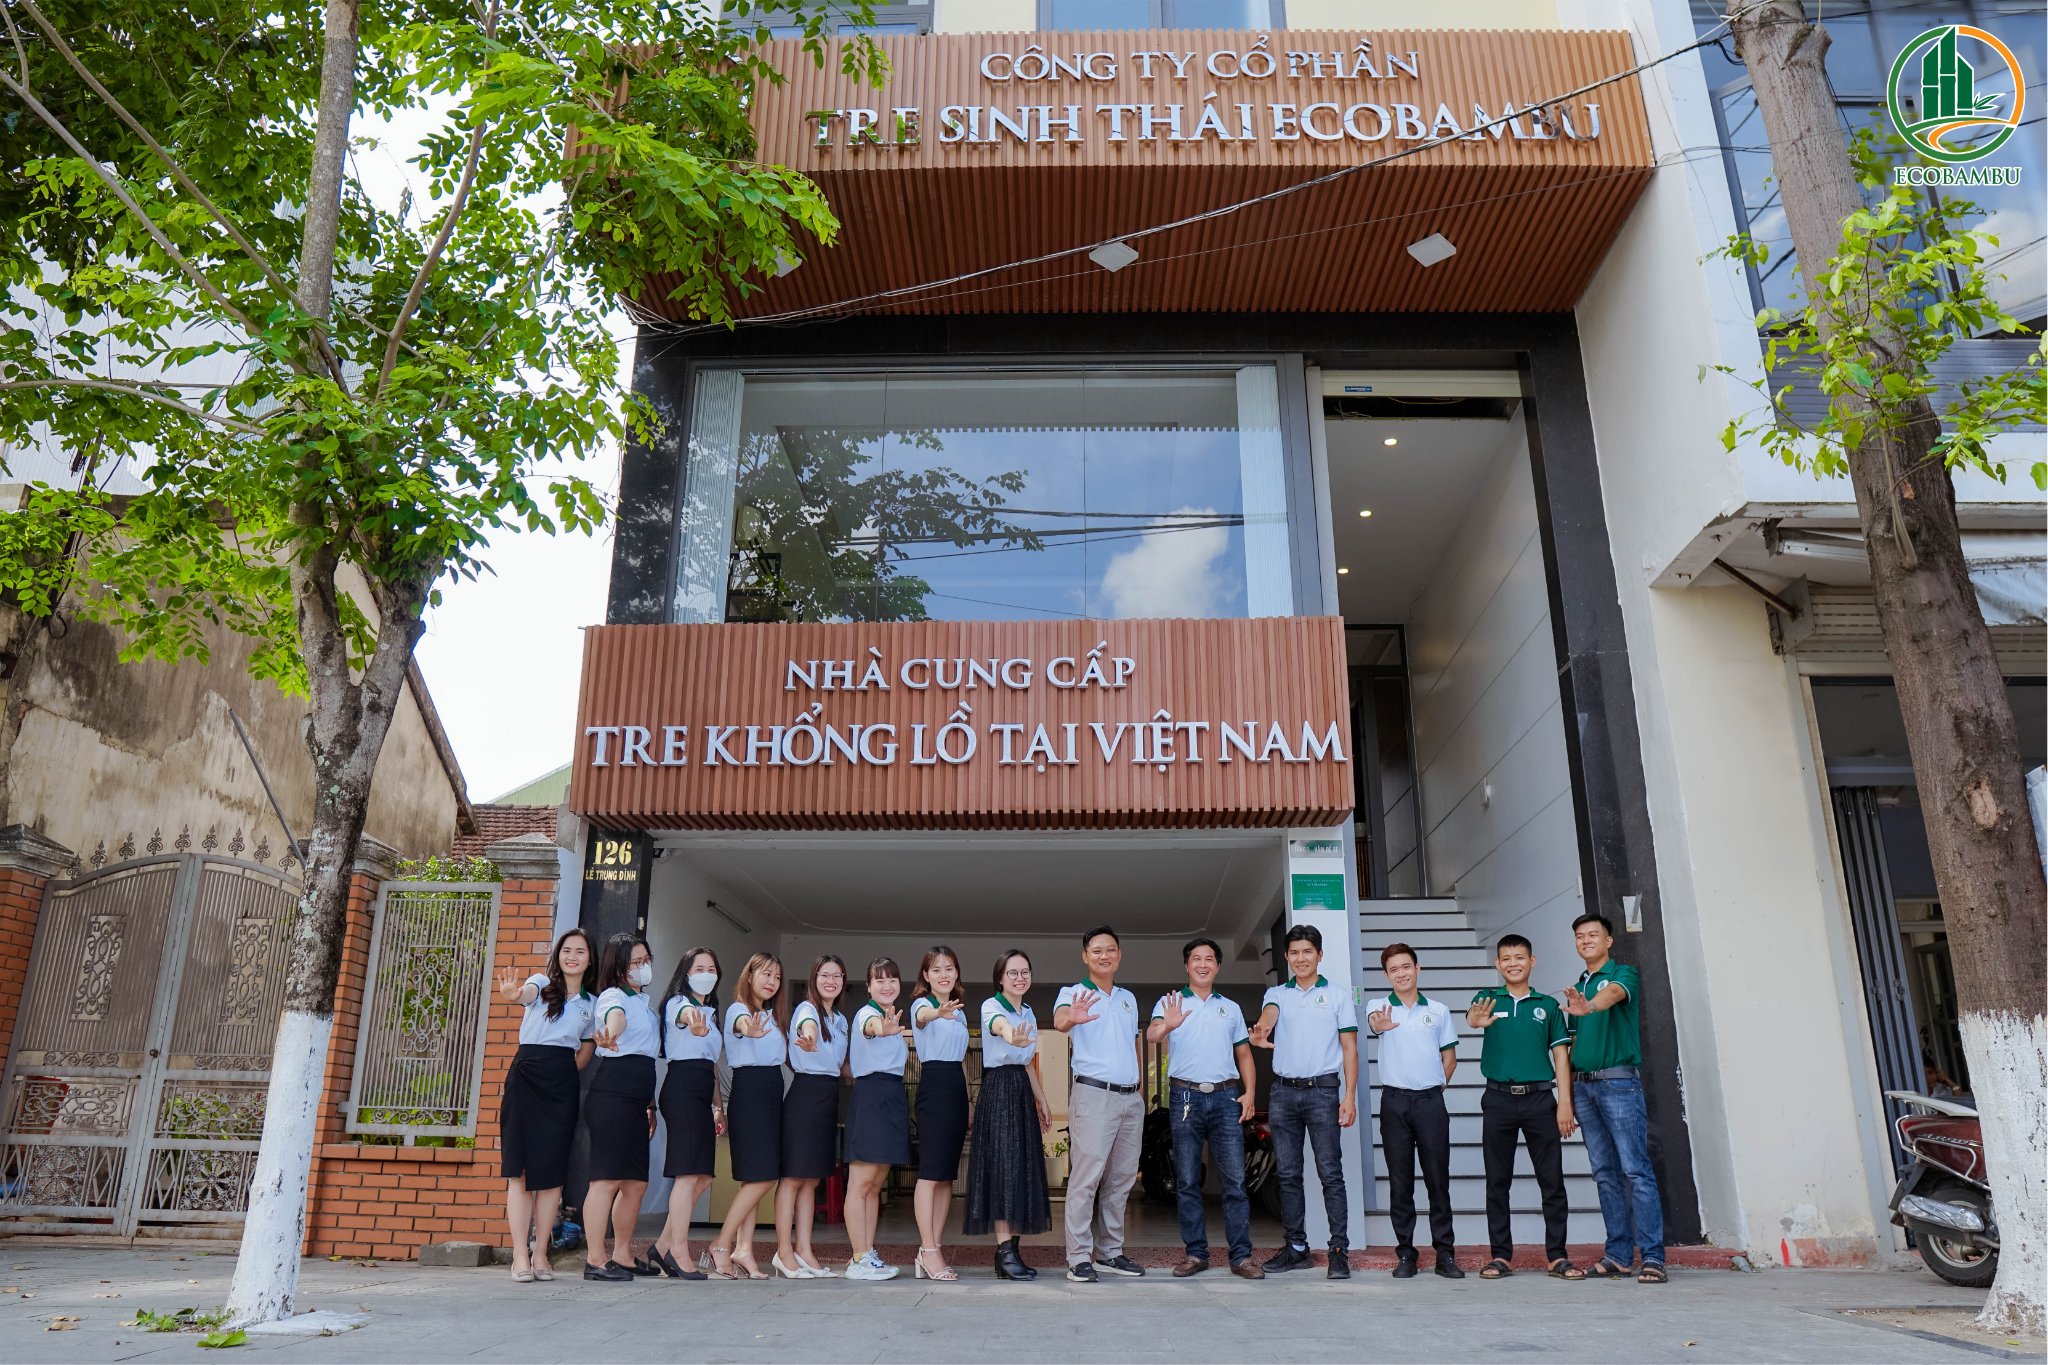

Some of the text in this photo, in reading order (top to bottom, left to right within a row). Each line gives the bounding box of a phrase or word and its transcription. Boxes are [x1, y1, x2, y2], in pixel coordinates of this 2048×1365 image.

[980, 34, 1419, 82] CÔNG TY CỔ PHẦN
[805, 91, 1601, 149] TRE SINH THÁI ECOBAMBU
[784, 640, 1136, 691] NHÀ CUNG CẤP
[585, 700, 1348, 774] TRE KHỔNG LỒ TẠI VIỆT NAM
[593, 840, 632, 866] 126
[595, 869, 618, 881] TRUNG
